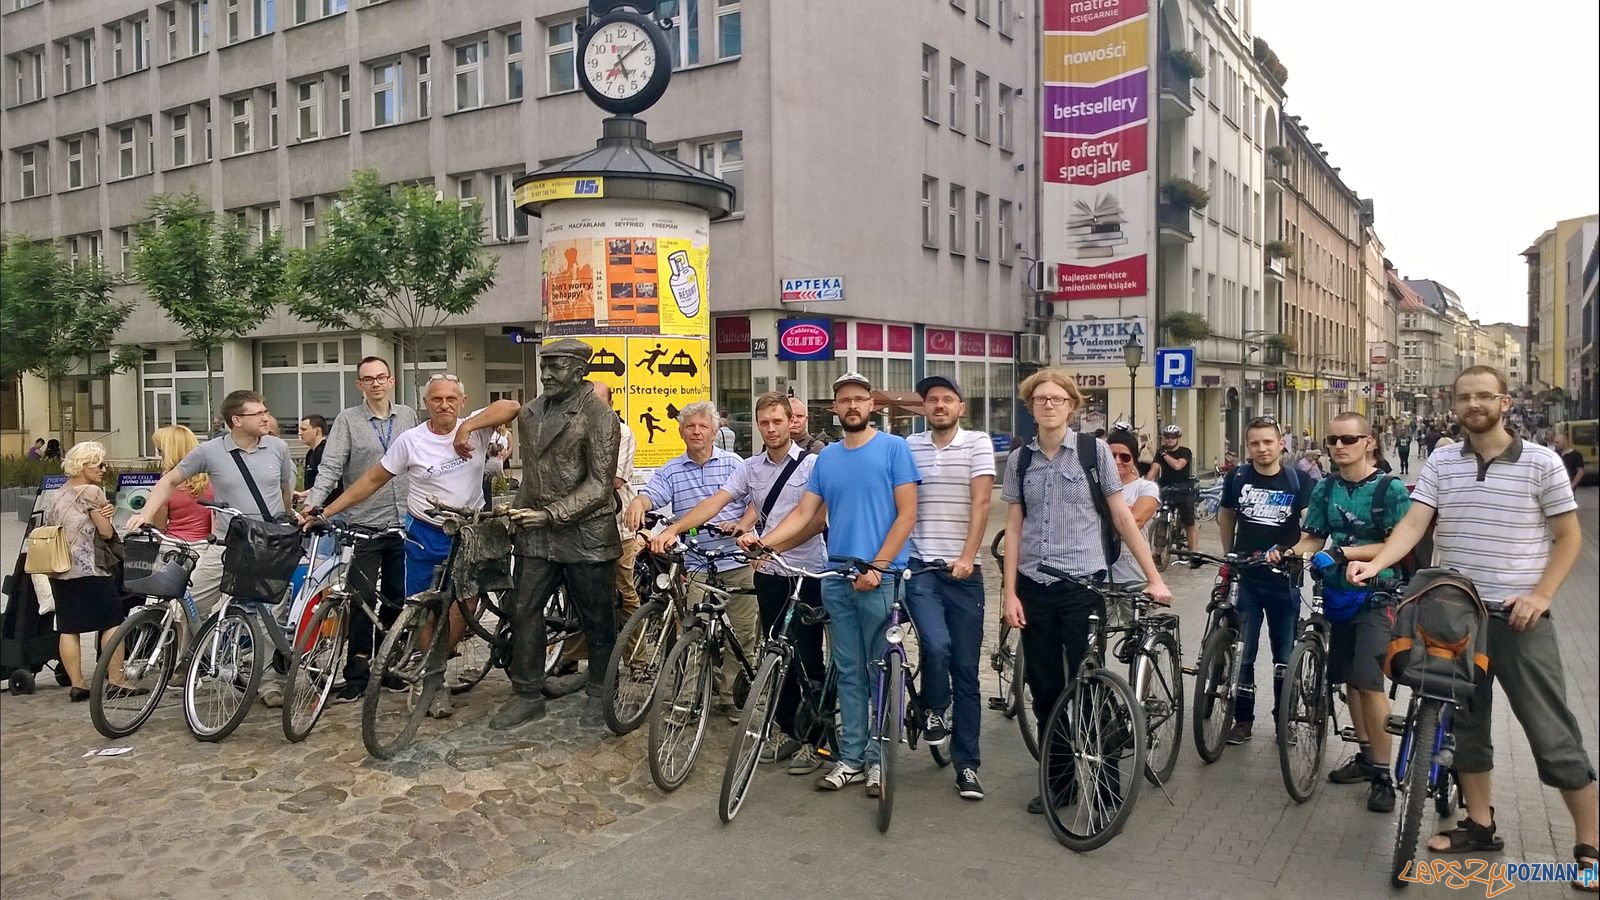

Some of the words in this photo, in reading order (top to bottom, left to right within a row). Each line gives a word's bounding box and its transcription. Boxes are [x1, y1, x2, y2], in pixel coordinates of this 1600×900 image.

[1070, 0, 1119, 13] matras
[1070, 9, 1119, 23] KSIĘGARNIE
[604, 34, 613, 43] 11
[616, 29, 628, 39] 12
[632, 32, 636, 41] 1
[595, 45, 606, 54] 10
[640, 42, 648, 51] 2
[1064, 41, 1126, 66] nowości
[591, 60, 598, 68] 9
[644, 56, 651, 66] 3
[595, 72, 602, 81] 8
[640, 71, 647, 79] 4
[606, 81, 613, 91] 7
[617, 84, 625, 94] 6
[630, 81, 638, 90] 5
[1054, 97, 1138, 119] bestsellery
[1071, 141, 1118, 159] oferty
[1059, 158, 1131, 181] specjalne
[568, 221, 606, 229] MACFARLANE
[1062, 273, 1098, 283] Najlepsze
[1098, 271, 1127, 281] miejsce
[568, 282, 594, 290] worry,
[785, 278, 841, 291] APTEKA
[1064, 282, 1109, 292] miłośników
[1108, 280, 1137, 291] książek
[560, 290, 584, 300] happy!
[790, 327, 819, 335] Cukiernia
[1063, 323, 1144, 337] APTEKA
[754, 341, 766, 350] 2/6
[786, 336, 823, 347] ELITE
[1071, 373, 1105, 387] tras
[629, 384, 677, 397] Strategie
